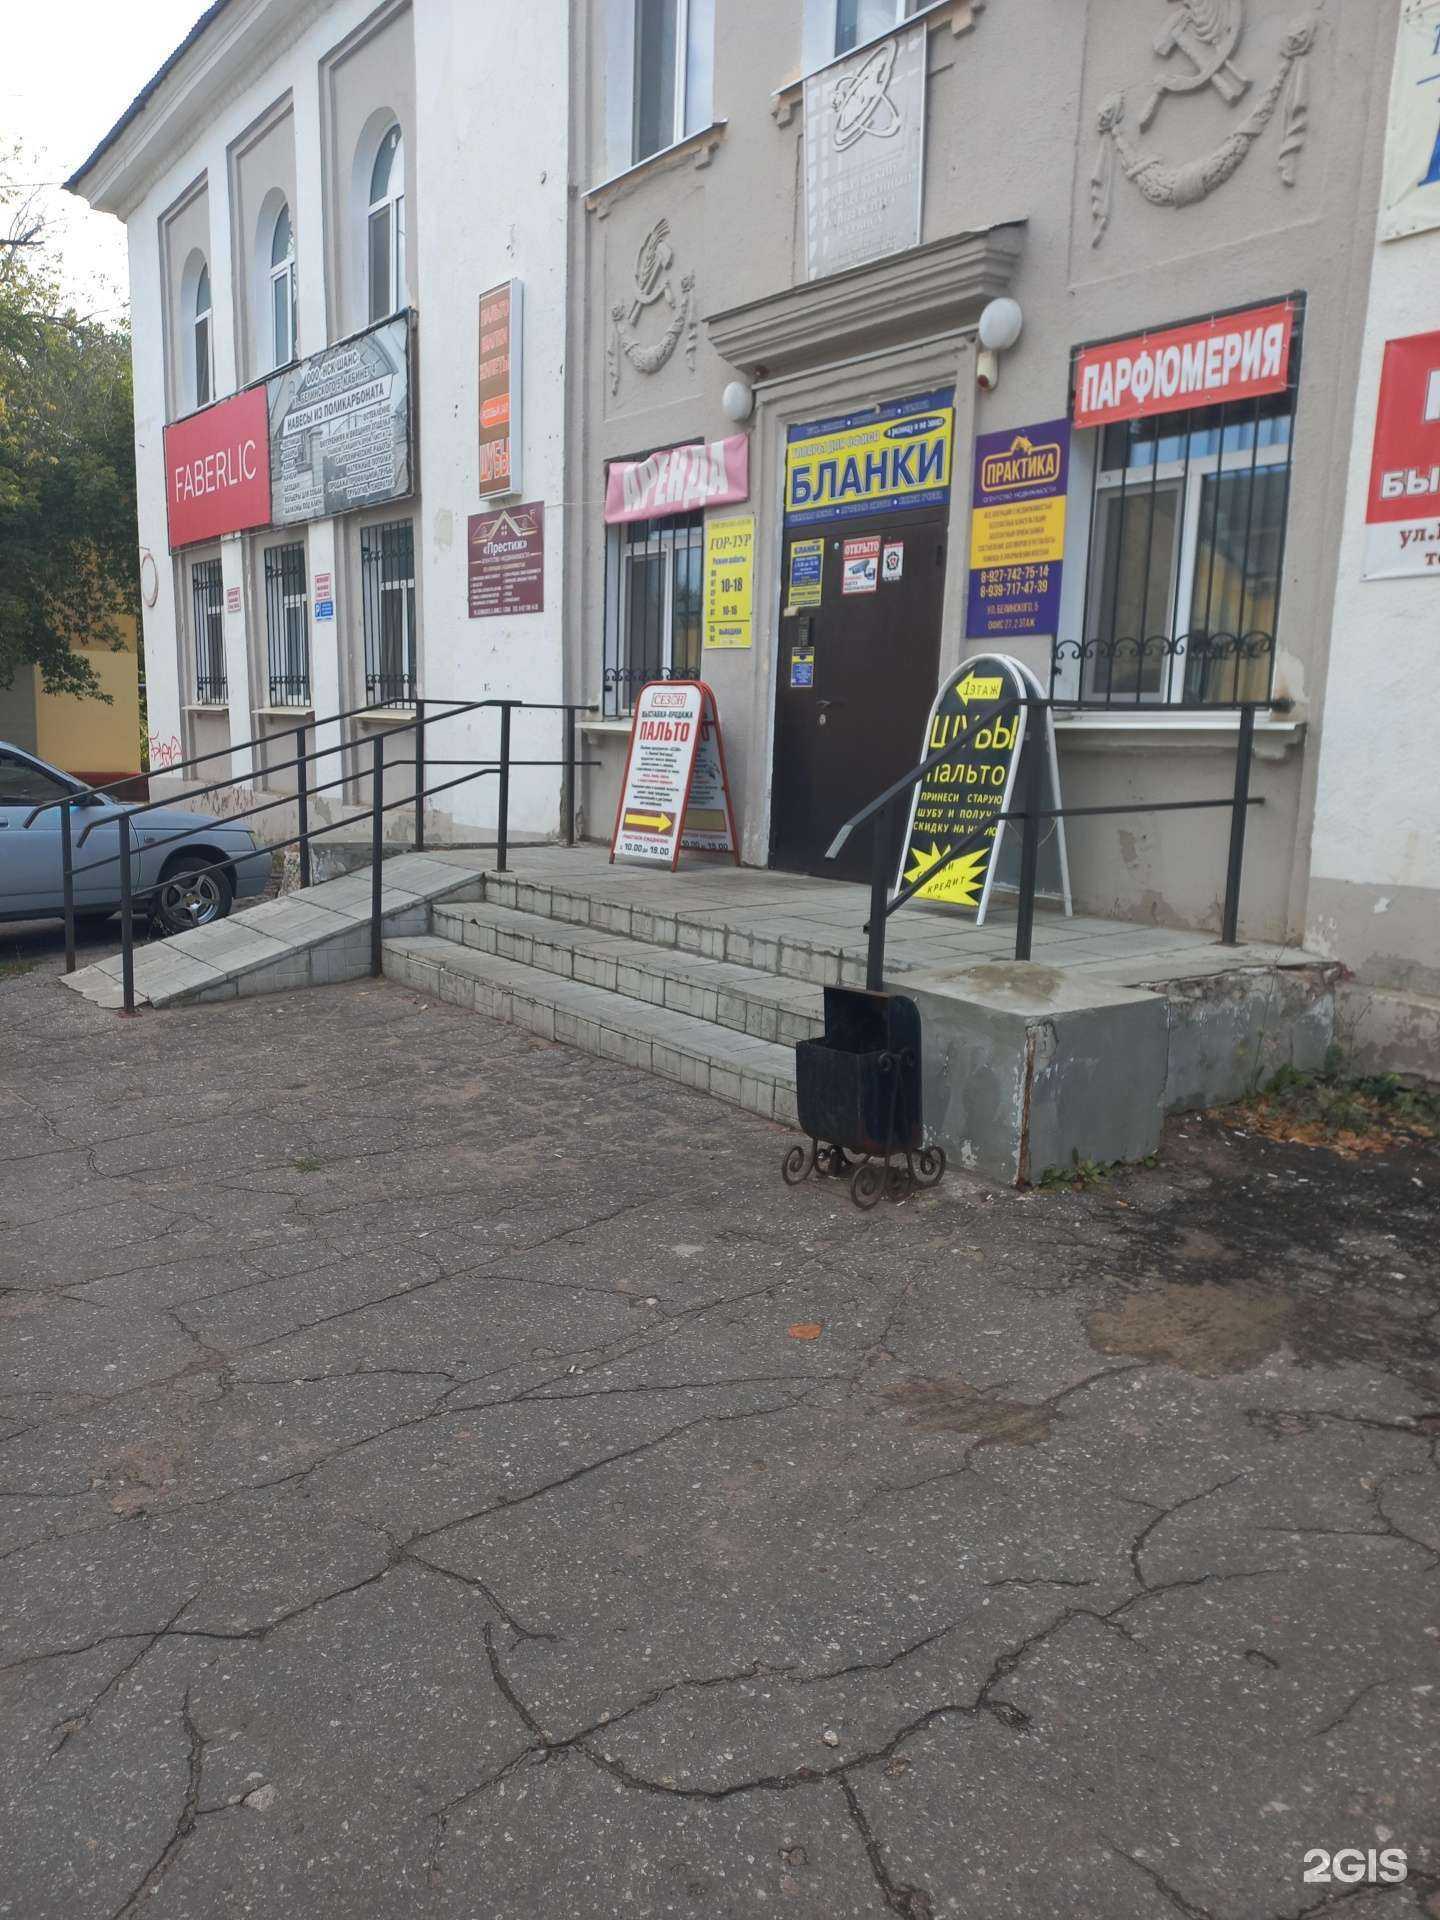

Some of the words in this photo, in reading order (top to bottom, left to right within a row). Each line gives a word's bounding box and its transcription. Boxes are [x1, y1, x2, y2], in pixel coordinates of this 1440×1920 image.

[1081, 322, 1284, 413] ПАРФЮМЕРИЯ
[287, 410, 313, 431] НАВЕСЫ
[314, 405, 323, 422] ИЗ
[323, 383, 385, 418] ПОЛИКАРБОНАТА
[175, 440, 257, 502] FABERLIC
[623, 440, 729, 513] АРЕНДА
[792, 438, 946, 506] БЛАНКИ
[986, 452, 1055, 485] ПРАКТИКА
[1399, 523, 1440, 550] ул.
[721, 577, 743, 593] 10-18
[639, 721, 690, 742] ПАЛЬТО
[921, 791, 960, 803] ПРИНЕСИ
[967, 793, 1003, 805] СТАРУЮ
[917, 807, 944, 818] ШУБУ
[948, 808, 955, 818] И
[960, 809, 998, 819] ПОЛУЧ
[913, 821, 949, 835] СКИДКУ
[953, 823, 965, 833] НА
[928, 876, 967, 894] КРЕДИТ
